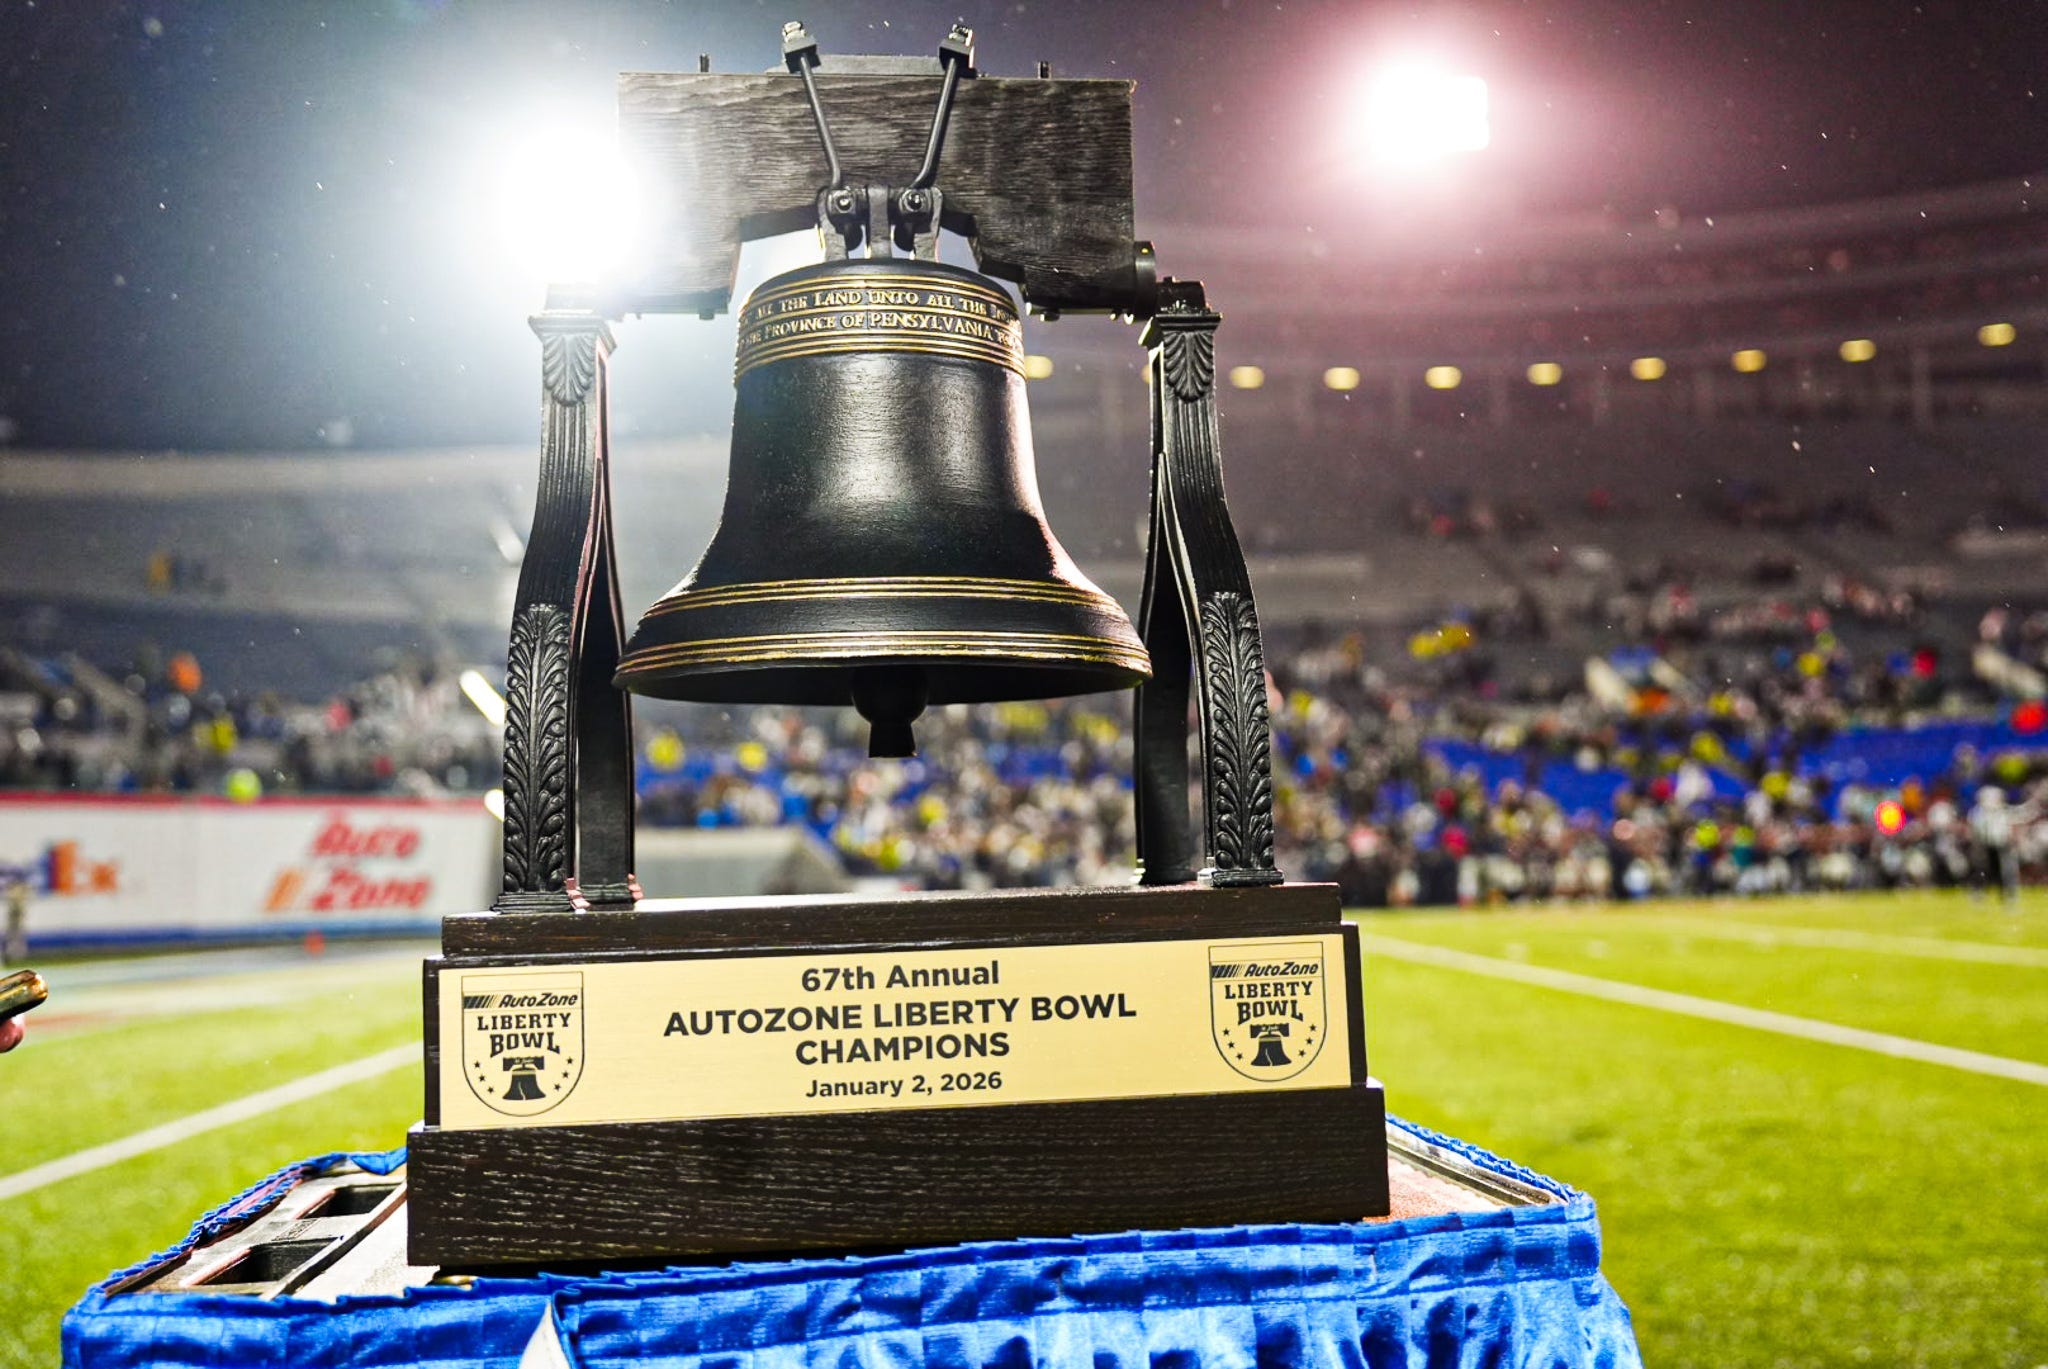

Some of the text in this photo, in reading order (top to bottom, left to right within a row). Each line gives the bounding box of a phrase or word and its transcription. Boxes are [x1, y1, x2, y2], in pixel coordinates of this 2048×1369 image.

[780, 296, 808, 313] THE
[814, 290, 862, 307] LAND
[867, 289, 919, 305] UNTO
[927, 293, 955, 309] ALL
[959, 297, 987, 315] THE
[764, 316, 836, 340] PROVINCE
[841, 314, 865, 328] OF
[870, 312, 994, 341] PENSYLVANIA
[801, 960, 999, 992] 67th Annual
[1243, 961, 1320, 978] AutoZone
[498, 992, 579, 1009] AutoZone
[1224, 980, 1313, 1000] LIBERTY
[477, 1012, 571, 1031] LIBERTY
[663, 993, 1137, 1037] AUTOZONE LIBERTY BOWL
[1236, 999, 1304, 1026] BOWL
[489, 1031, 561, 1058] BOWL
[795, 1032, 1010, 1066] CHAMPIONS
[805, 1071, 1003, 1098] January 2, 2026
